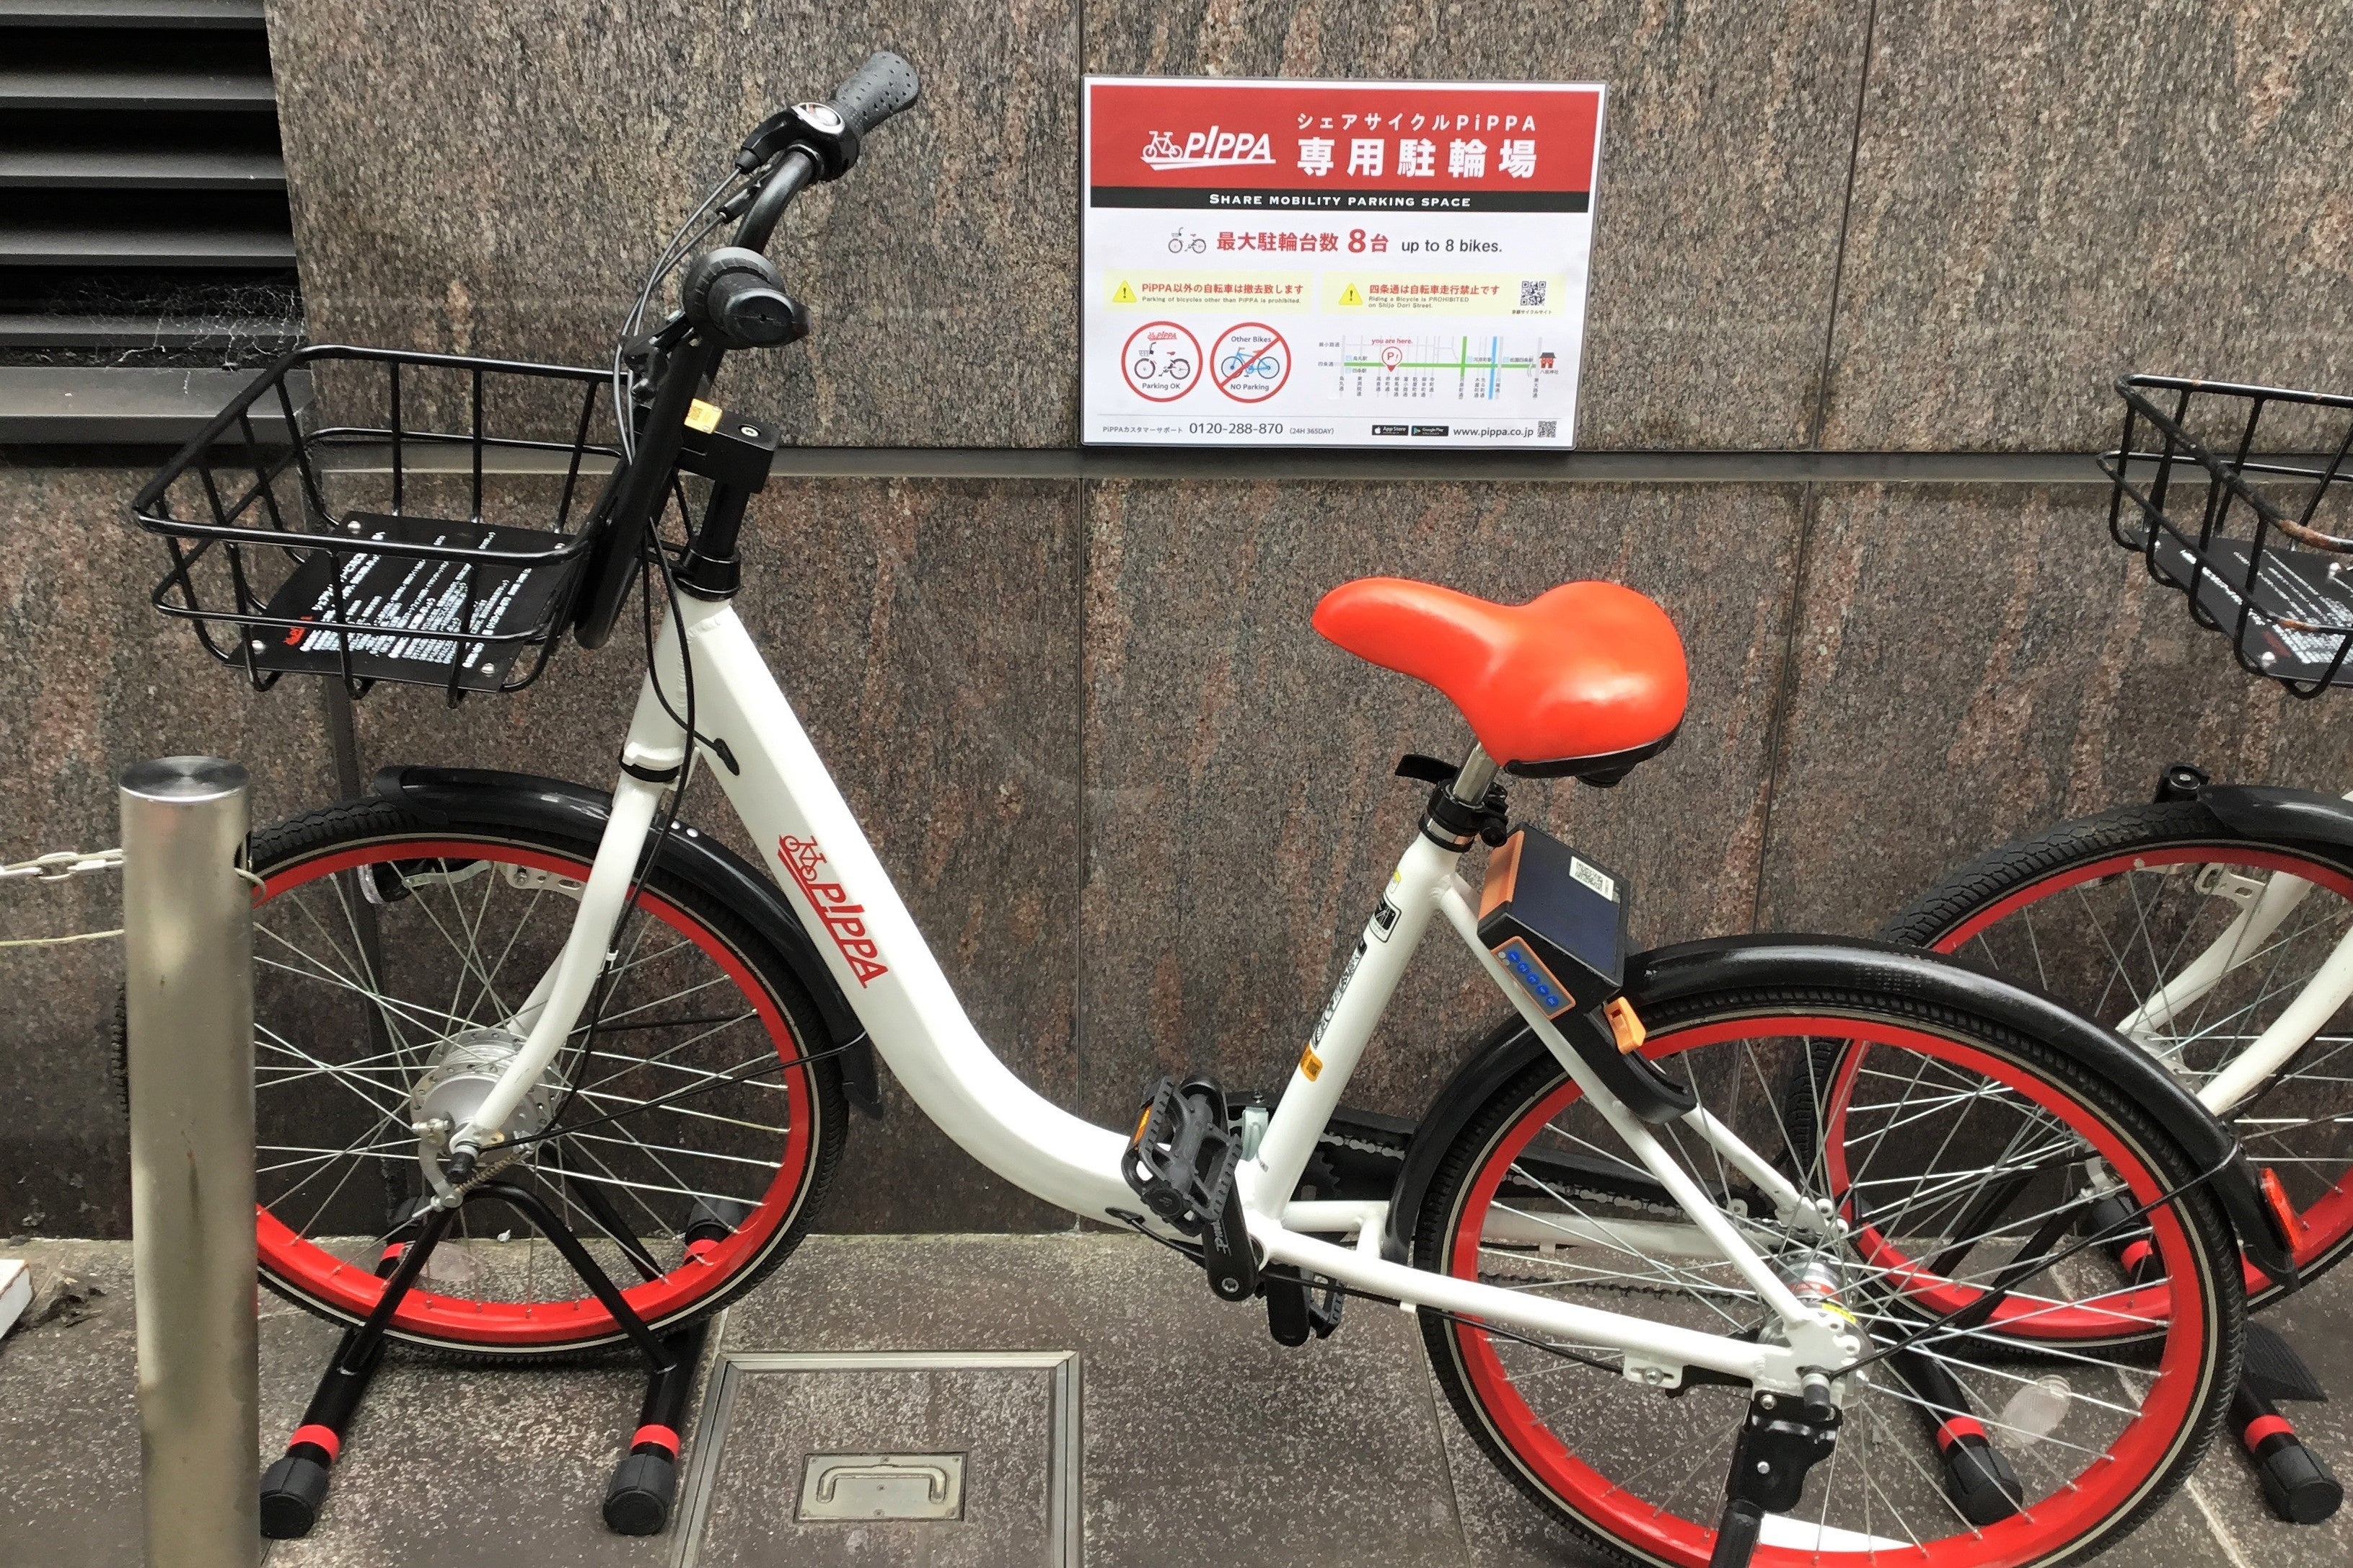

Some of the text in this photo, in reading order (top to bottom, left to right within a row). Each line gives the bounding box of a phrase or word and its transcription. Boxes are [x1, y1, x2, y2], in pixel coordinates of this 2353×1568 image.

[1297, 113, 1536, 131] シェアサイクルPiPPA
[1297, 136, 1538, 178] 専用駐輪場
[1269, 195, 1341, 206] MOBILITY
[1347, 196, 1415, 207] PARKING
[1420, 197, 1472, 208] SPACE
[1401, 241, 1420, 254] up
[1425, 239, 1440, 252] to
[1445, 239, 1455, 252] 8
[1459, 239, 1503, 253] bikes.
[1141, 283, 1303, 294] PiPPA以外の自転車は撤去致します
[1369, 284, 1500, 295] 四条通は自転車走行禁止です
[1189, 423, 1284, 435] 0120-288-870
[1453, 427, 1534, 438] www.pippa.co.jp
